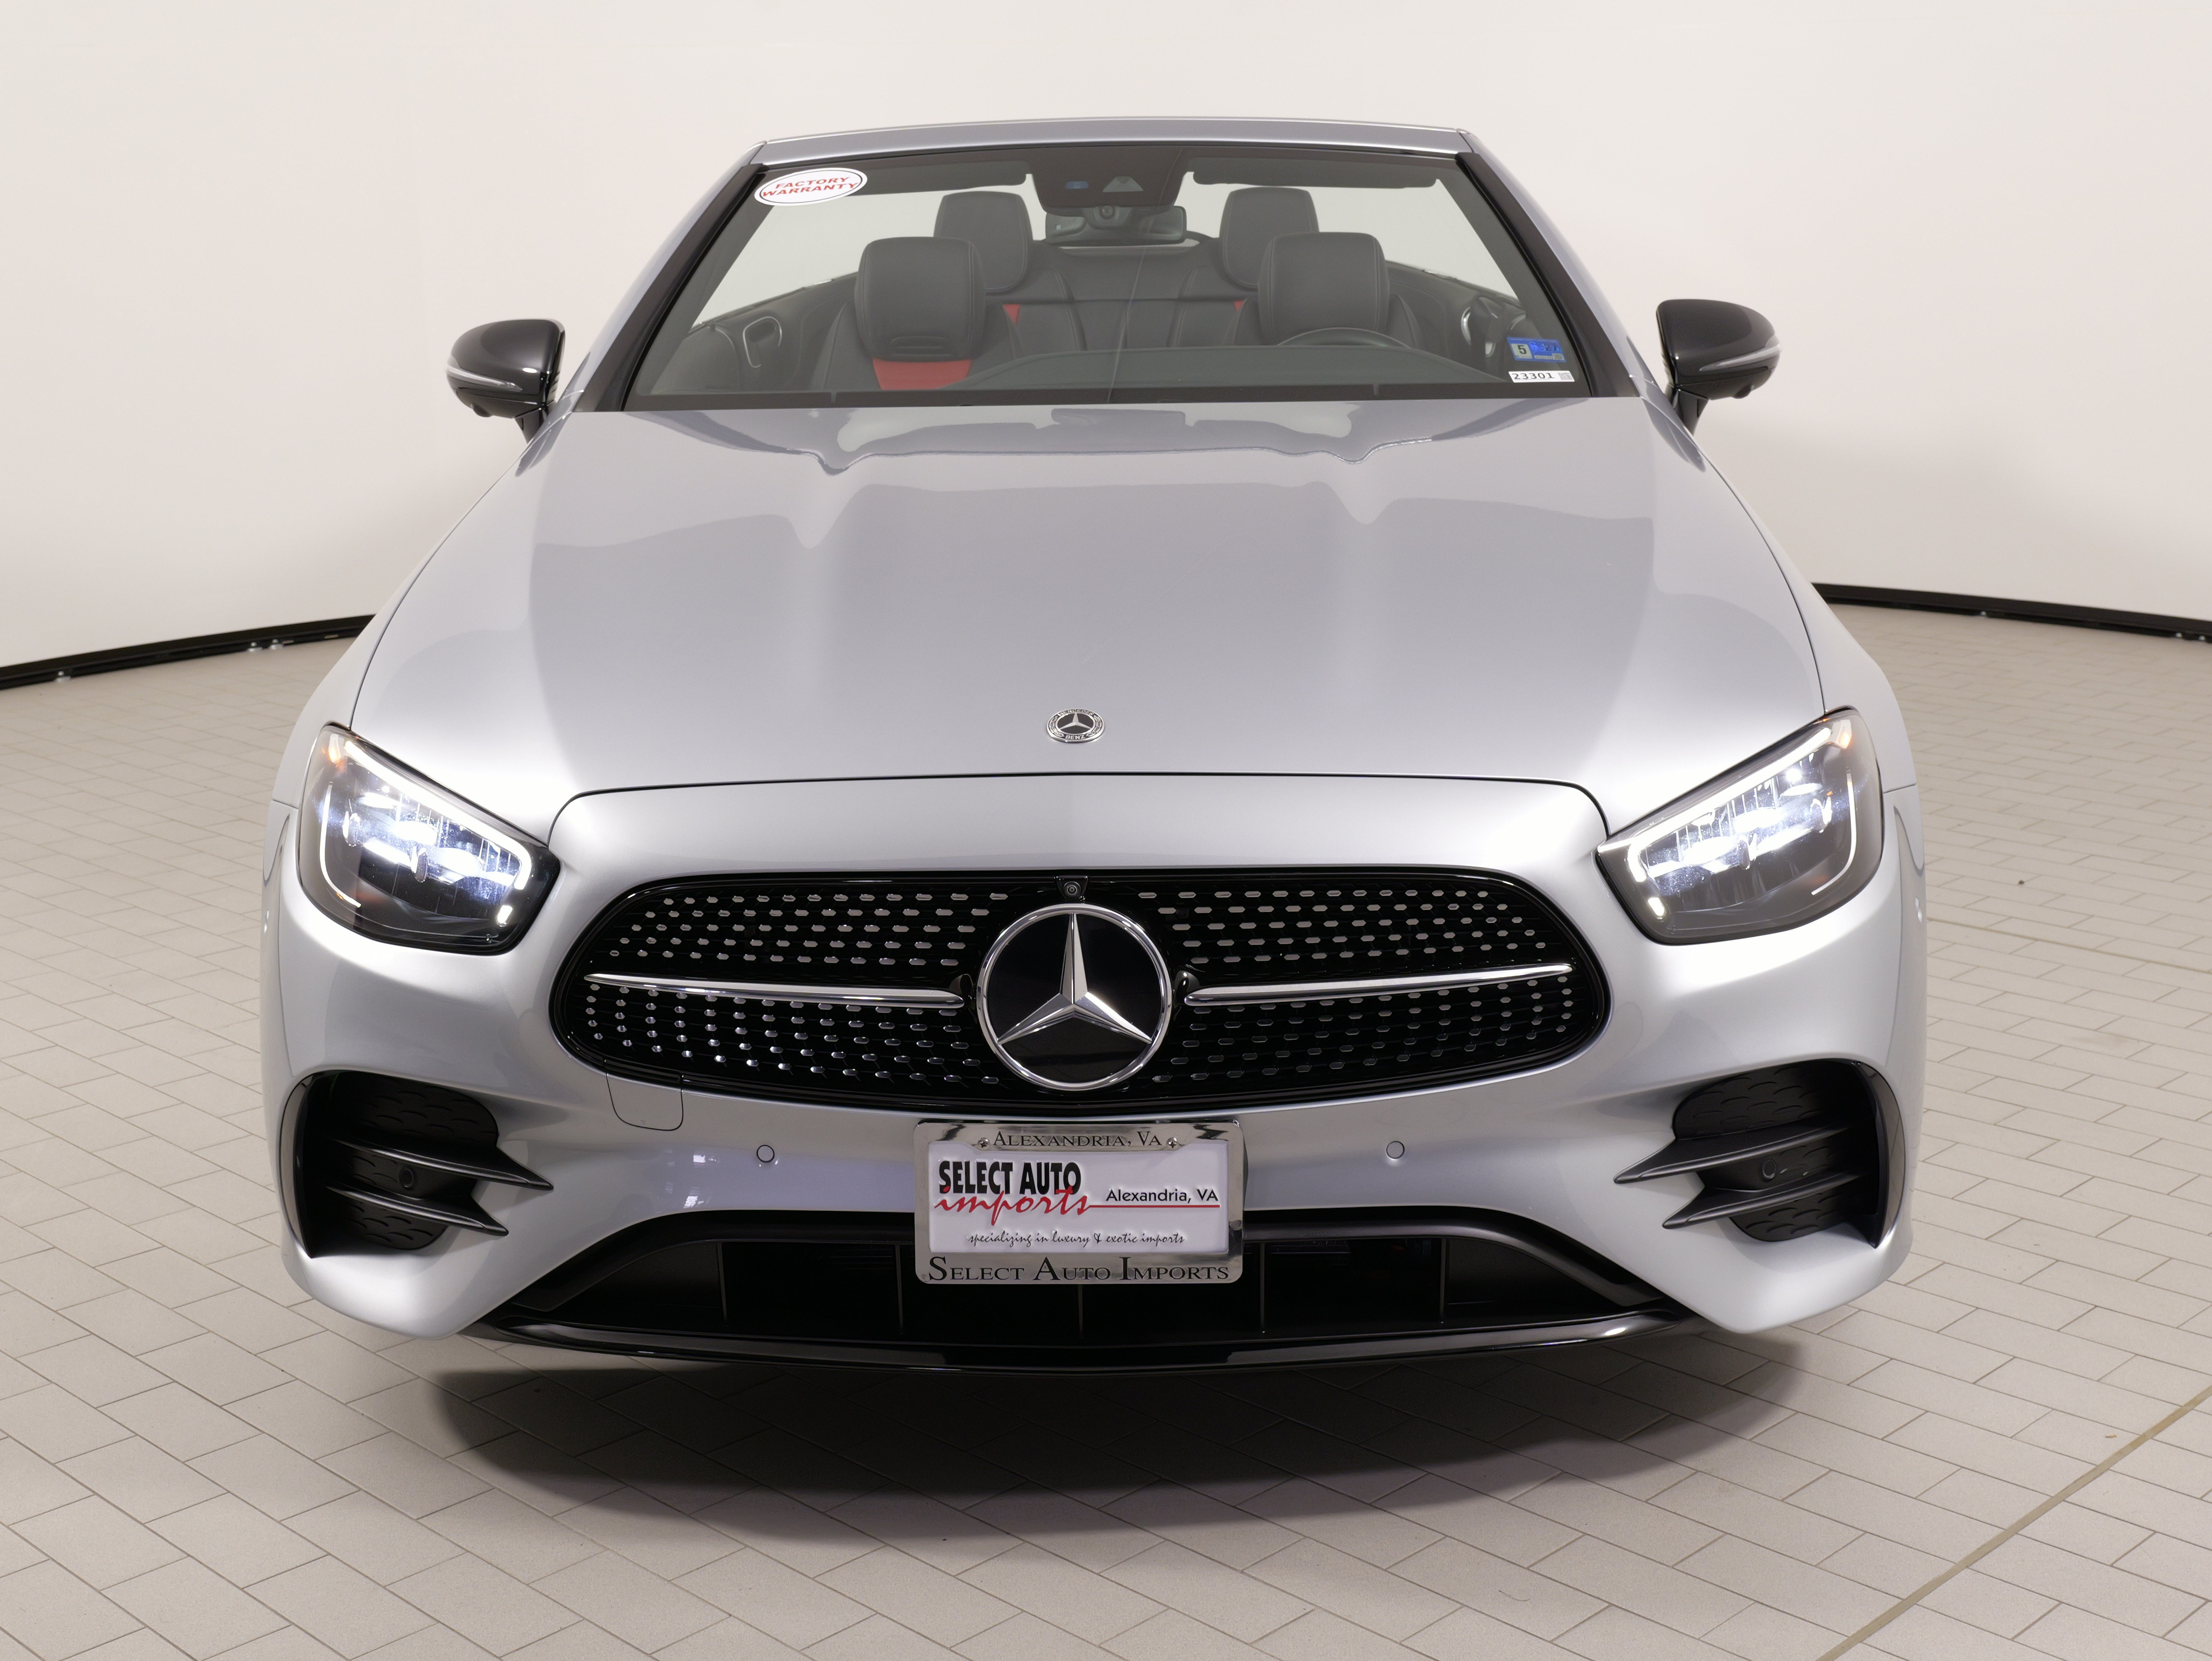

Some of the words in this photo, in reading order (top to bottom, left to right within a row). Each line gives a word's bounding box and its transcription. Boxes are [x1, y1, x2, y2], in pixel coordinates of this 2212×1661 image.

[763, 182, 859, 196] WARRANTY
[776, 177, 850, 189] FACTORY
[1517, 345, 1527, 355] 5
[939, 1160, 1013, 1195] SELECT
[1019, 1162, 1082, 1195] AUTO
[1106, 1188, 1192, 1204] Alexandria,
[1196, 1188, 1219, 1201] VA
[934, 1185, 1091, 1226] imports
[968, 1230, 1033, 1247] specializing
[1035, 1232, 1049, 1242] in
[1051, 1230, 1091, 1248] luxury
[1093, 1232, 1102, 1244] &
[1105, 1232, 1138, 1243] exotic
[1140, 1232, 1185, 1247] imports
[929, 1256, 1025, 1281] SELECT
[1033, 1256, 1111, 1281] AUTO
[1119, 1257, 1229, 1281] IMPORTS
